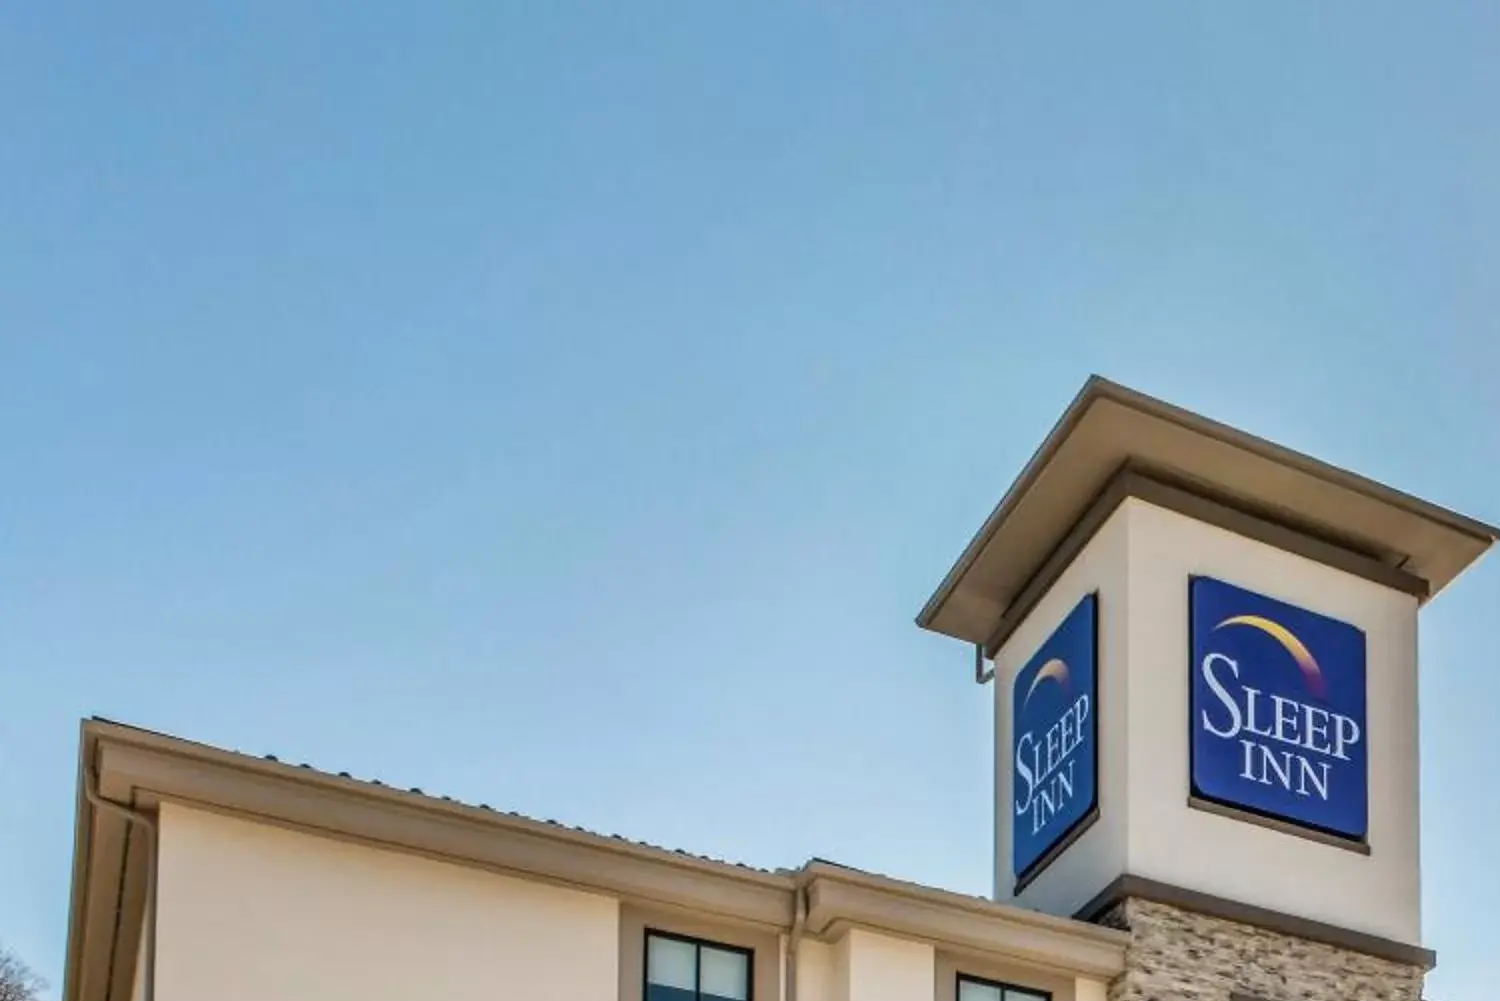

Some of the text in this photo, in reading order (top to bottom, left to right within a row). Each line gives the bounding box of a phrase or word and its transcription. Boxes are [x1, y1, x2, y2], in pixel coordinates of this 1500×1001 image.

[1202, 653, 1360, 761] SLEEP
[1016, 694, 1089, 815] SLEEP
[1032, 759, 1075, 835] INN
[1239, 739, 1332, 801] INN
